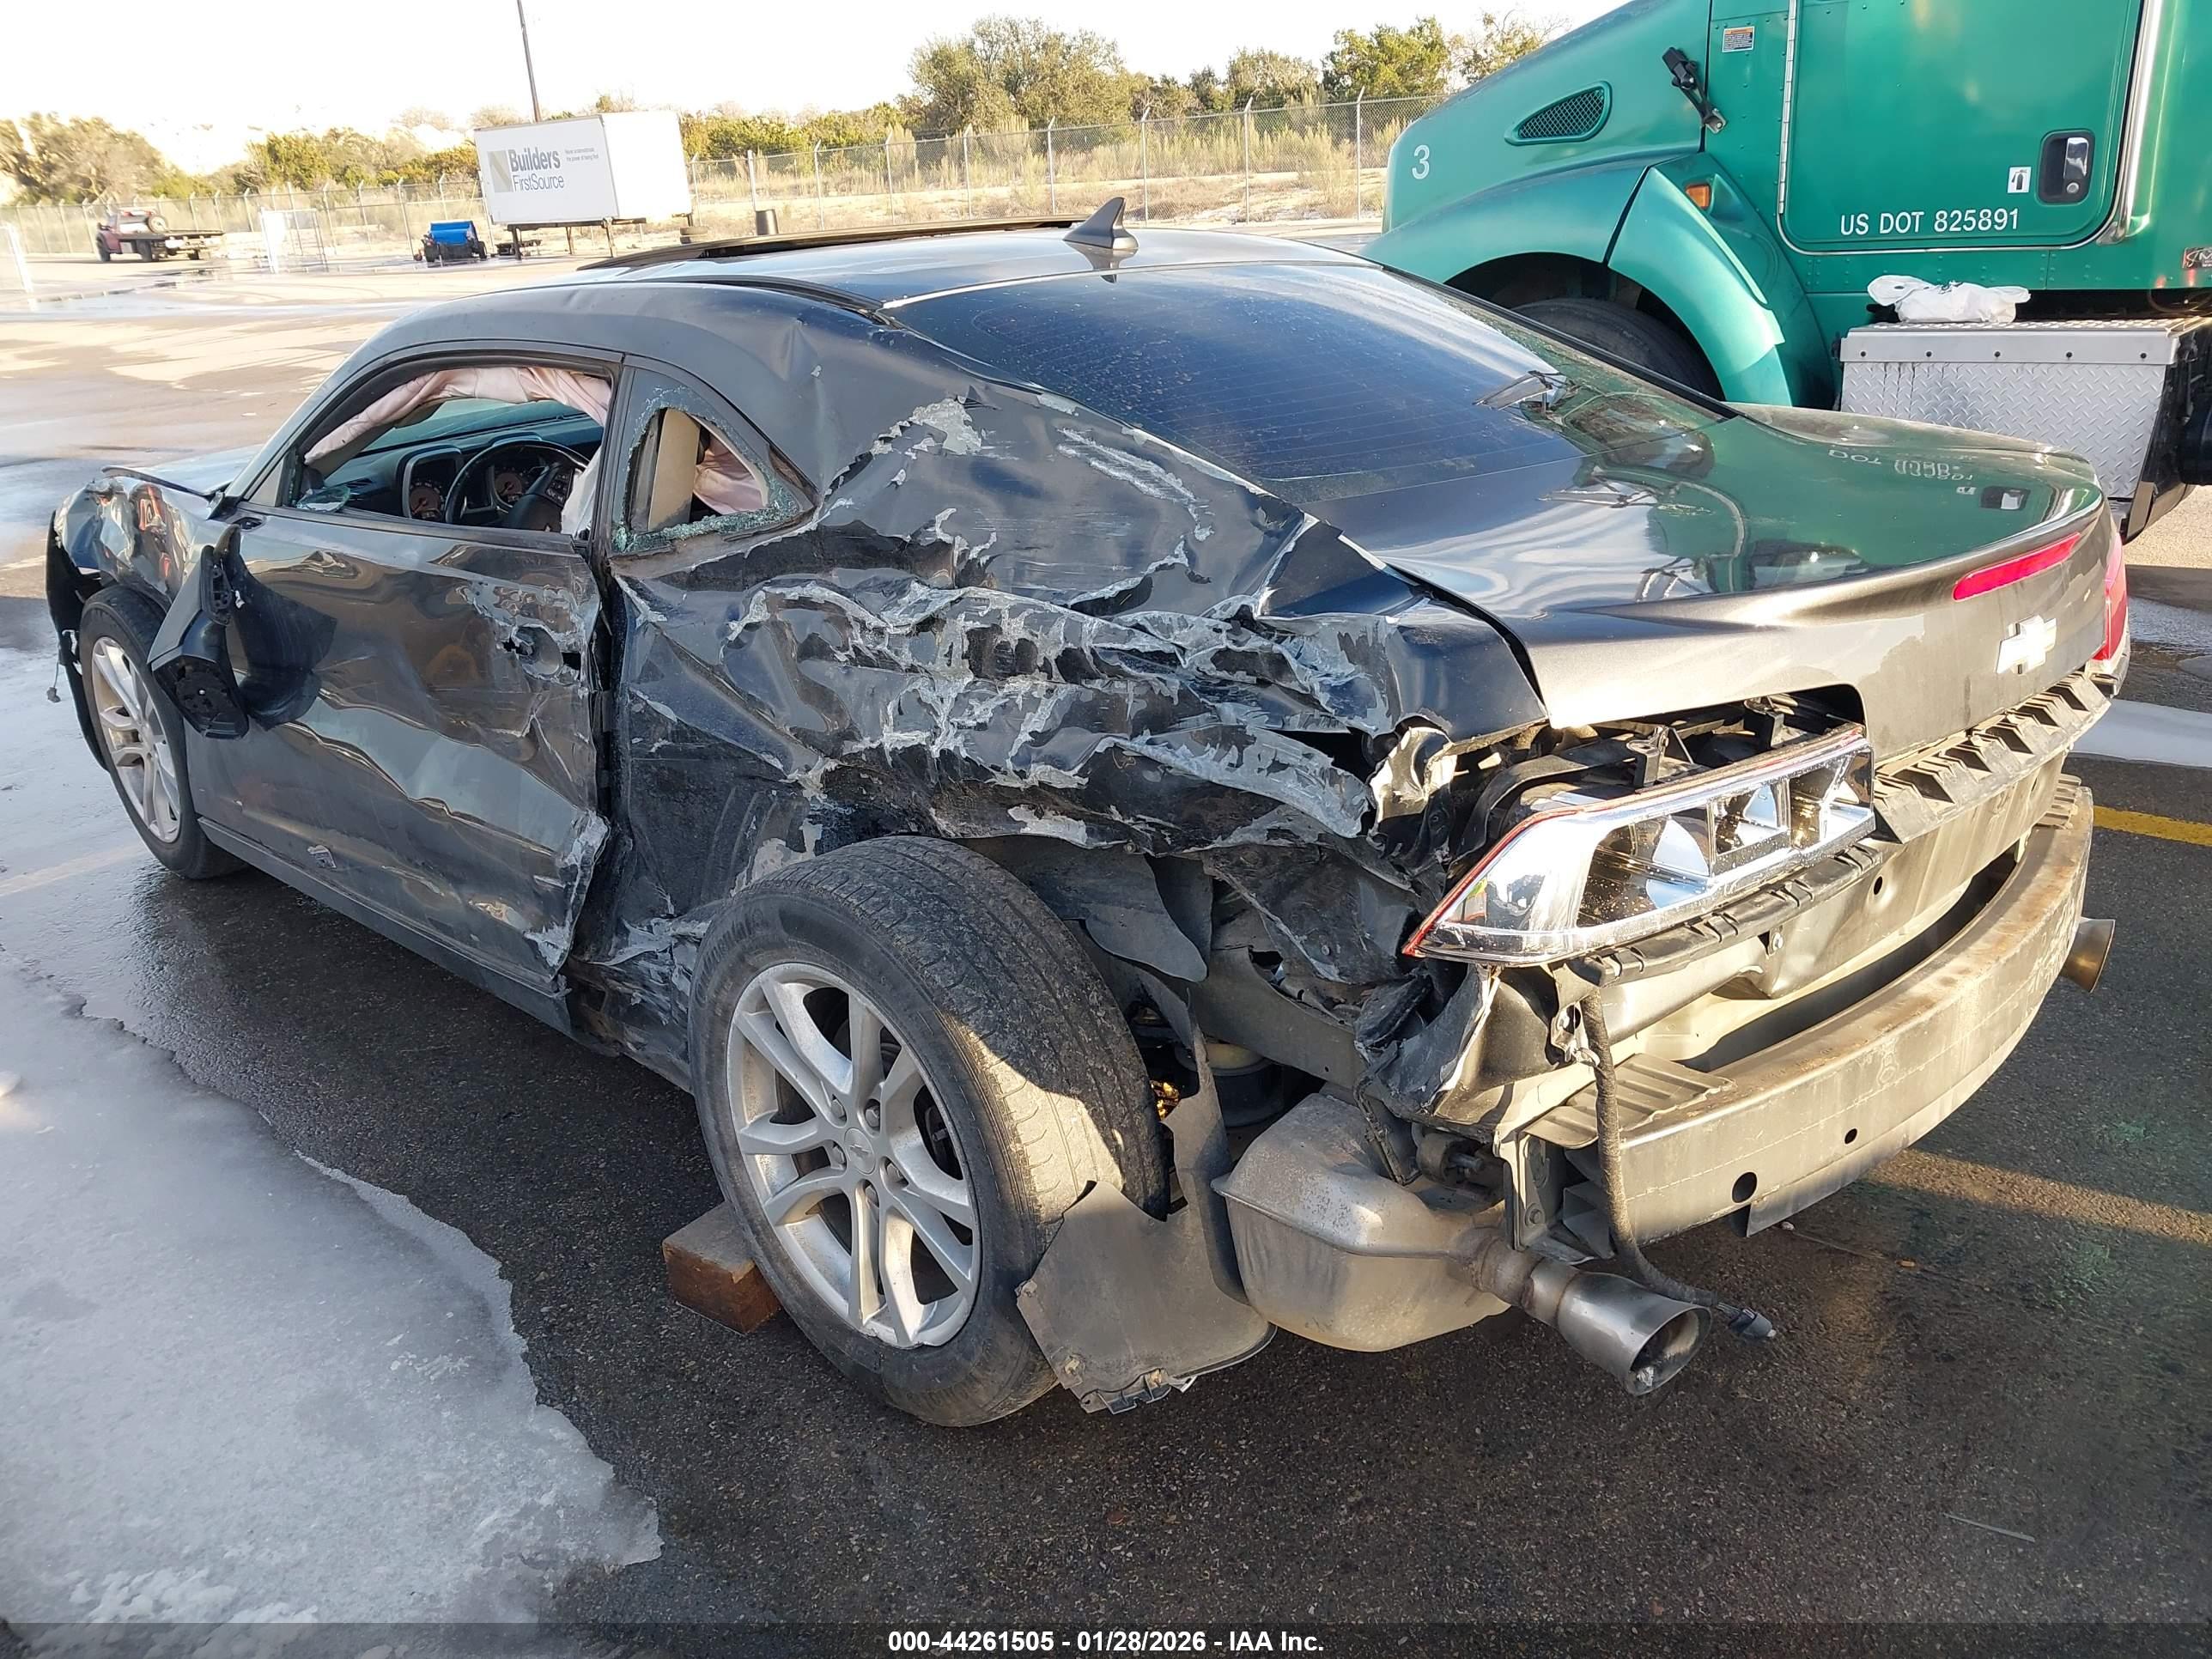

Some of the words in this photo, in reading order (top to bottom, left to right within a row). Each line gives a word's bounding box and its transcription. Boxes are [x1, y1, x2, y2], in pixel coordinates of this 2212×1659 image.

[508, 147, 561, 172] Builders
[1412, 144, 1430, 179] 3
[513, 173, 565, 191] FirstSource
[1840, 214, 1869, 235] US
[1880, 211, 1924, 234] DOT
[1934, 208, 2019, 233] 825891
